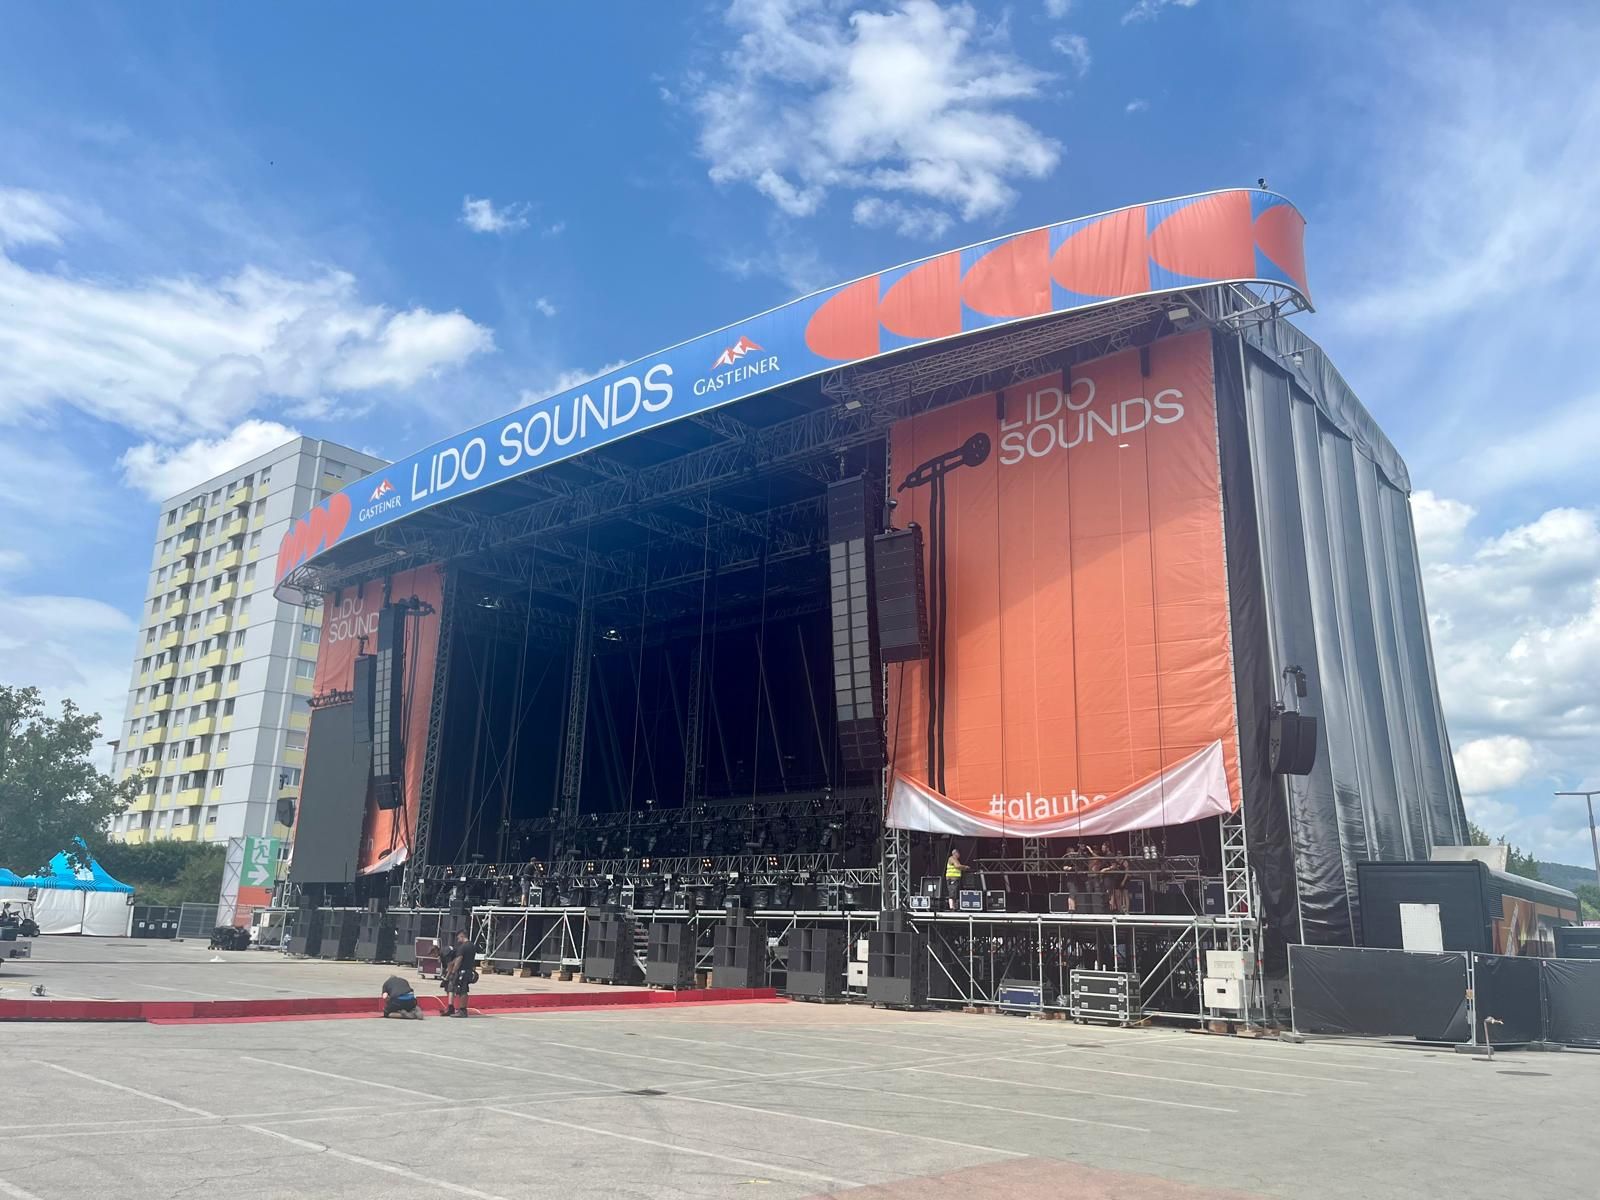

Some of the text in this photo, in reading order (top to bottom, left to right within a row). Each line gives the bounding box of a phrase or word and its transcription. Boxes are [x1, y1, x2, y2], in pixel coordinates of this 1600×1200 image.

[693, 356, 780, 396] GASTEINER
[411, 363, 674, 501] LIDO SOUNDS
[1000, 377, 1096, 432] LIDO
[1000, 388, 1185, 465] SOUNDS
[359, 495, 402, 522] GASTEINER
